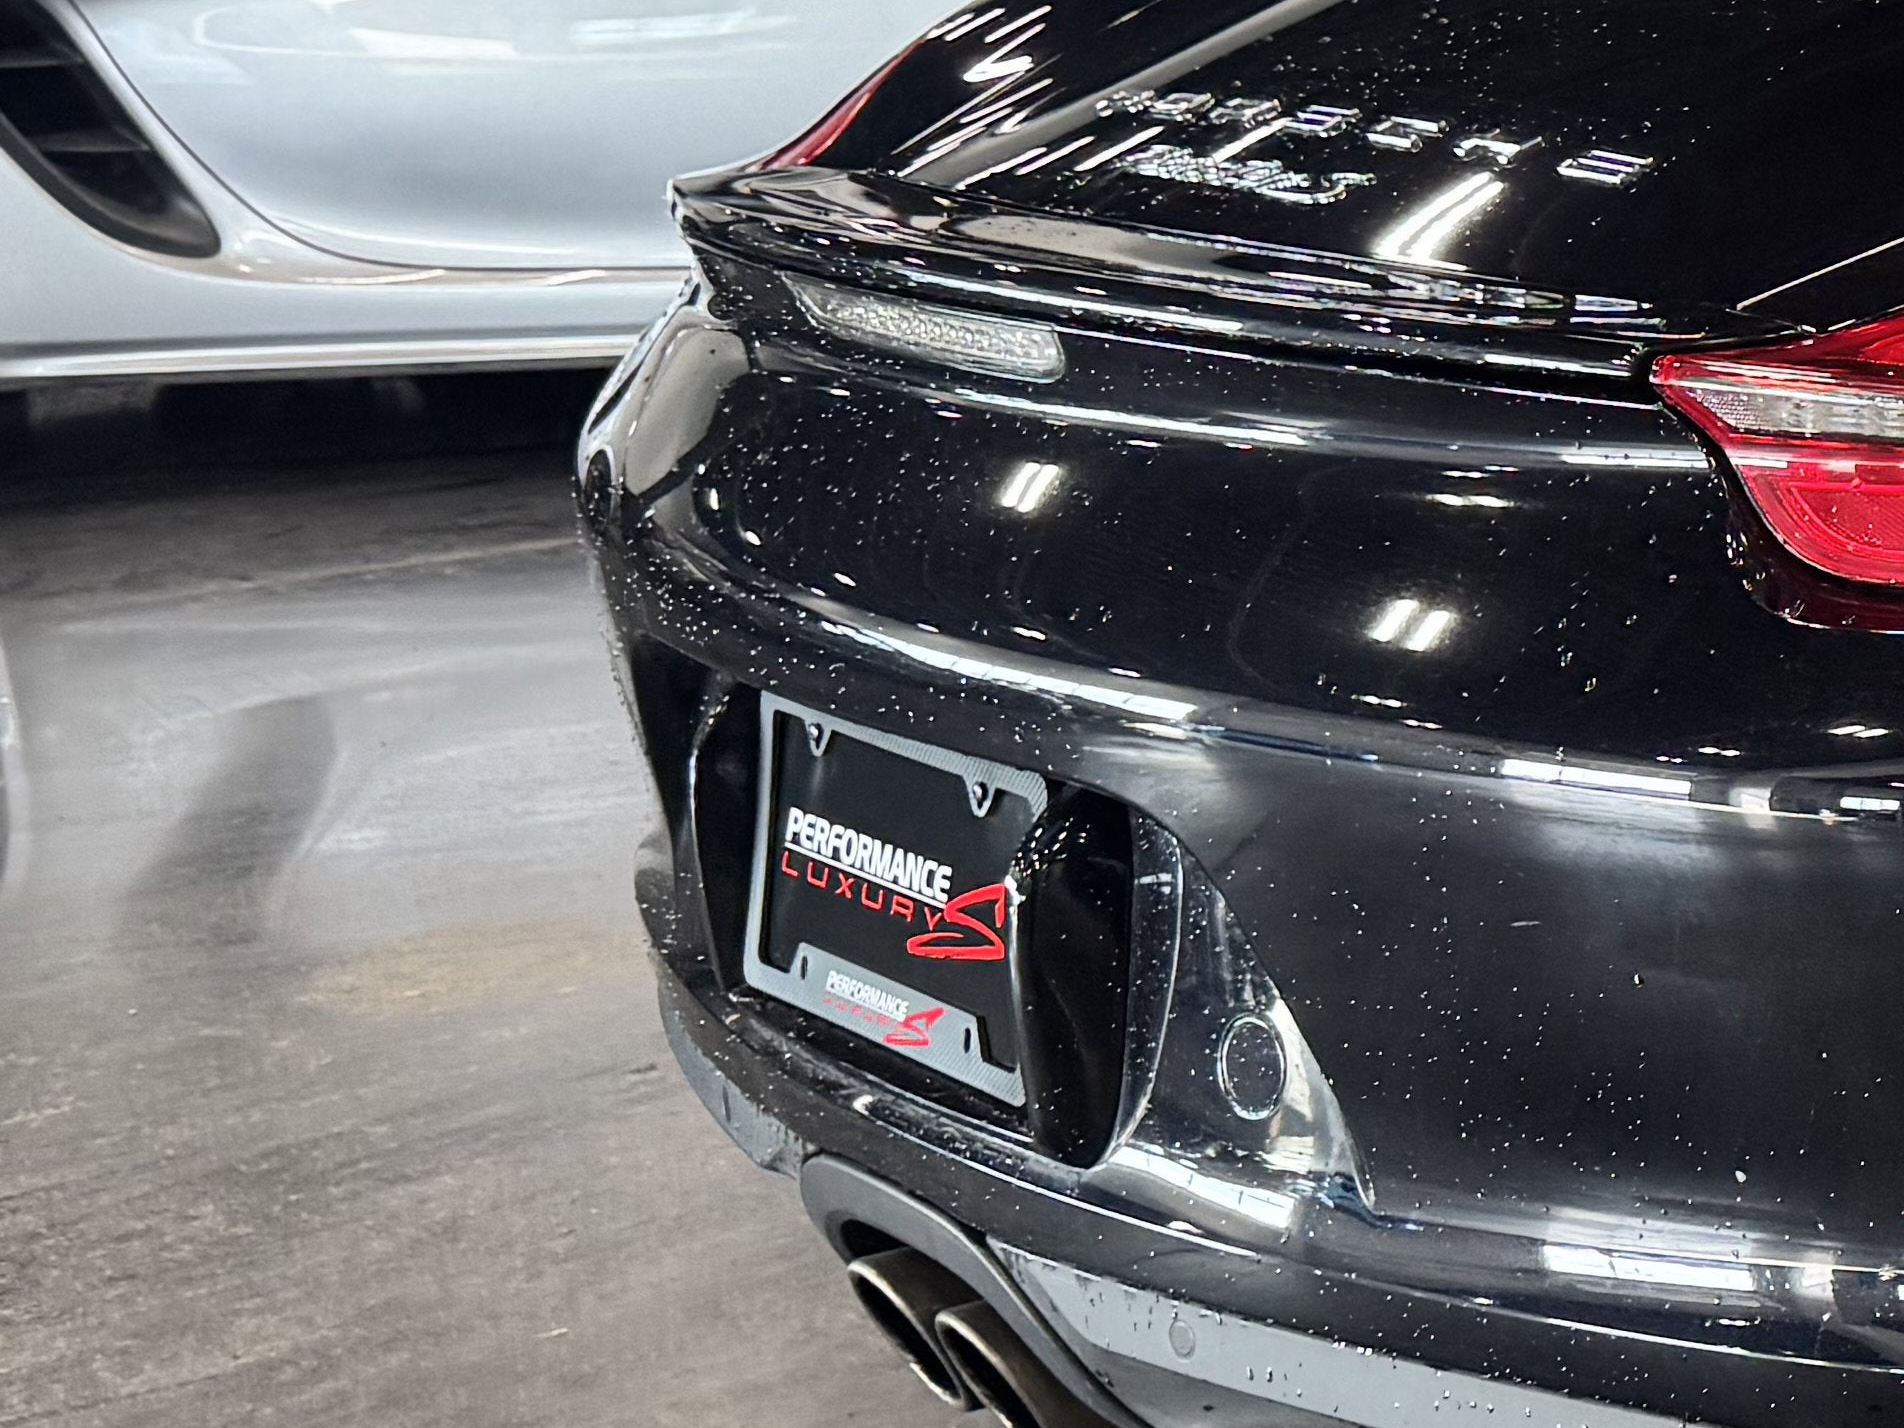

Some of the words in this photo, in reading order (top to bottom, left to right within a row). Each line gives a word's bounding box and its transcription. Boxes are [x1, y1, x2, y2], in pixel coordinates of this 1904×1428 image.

[781, 850, 943, 932] LUXURY
[785, 806, 953, 903] PERFORMANCE
[825, 970, 910, 1019] PERFORMANCE
